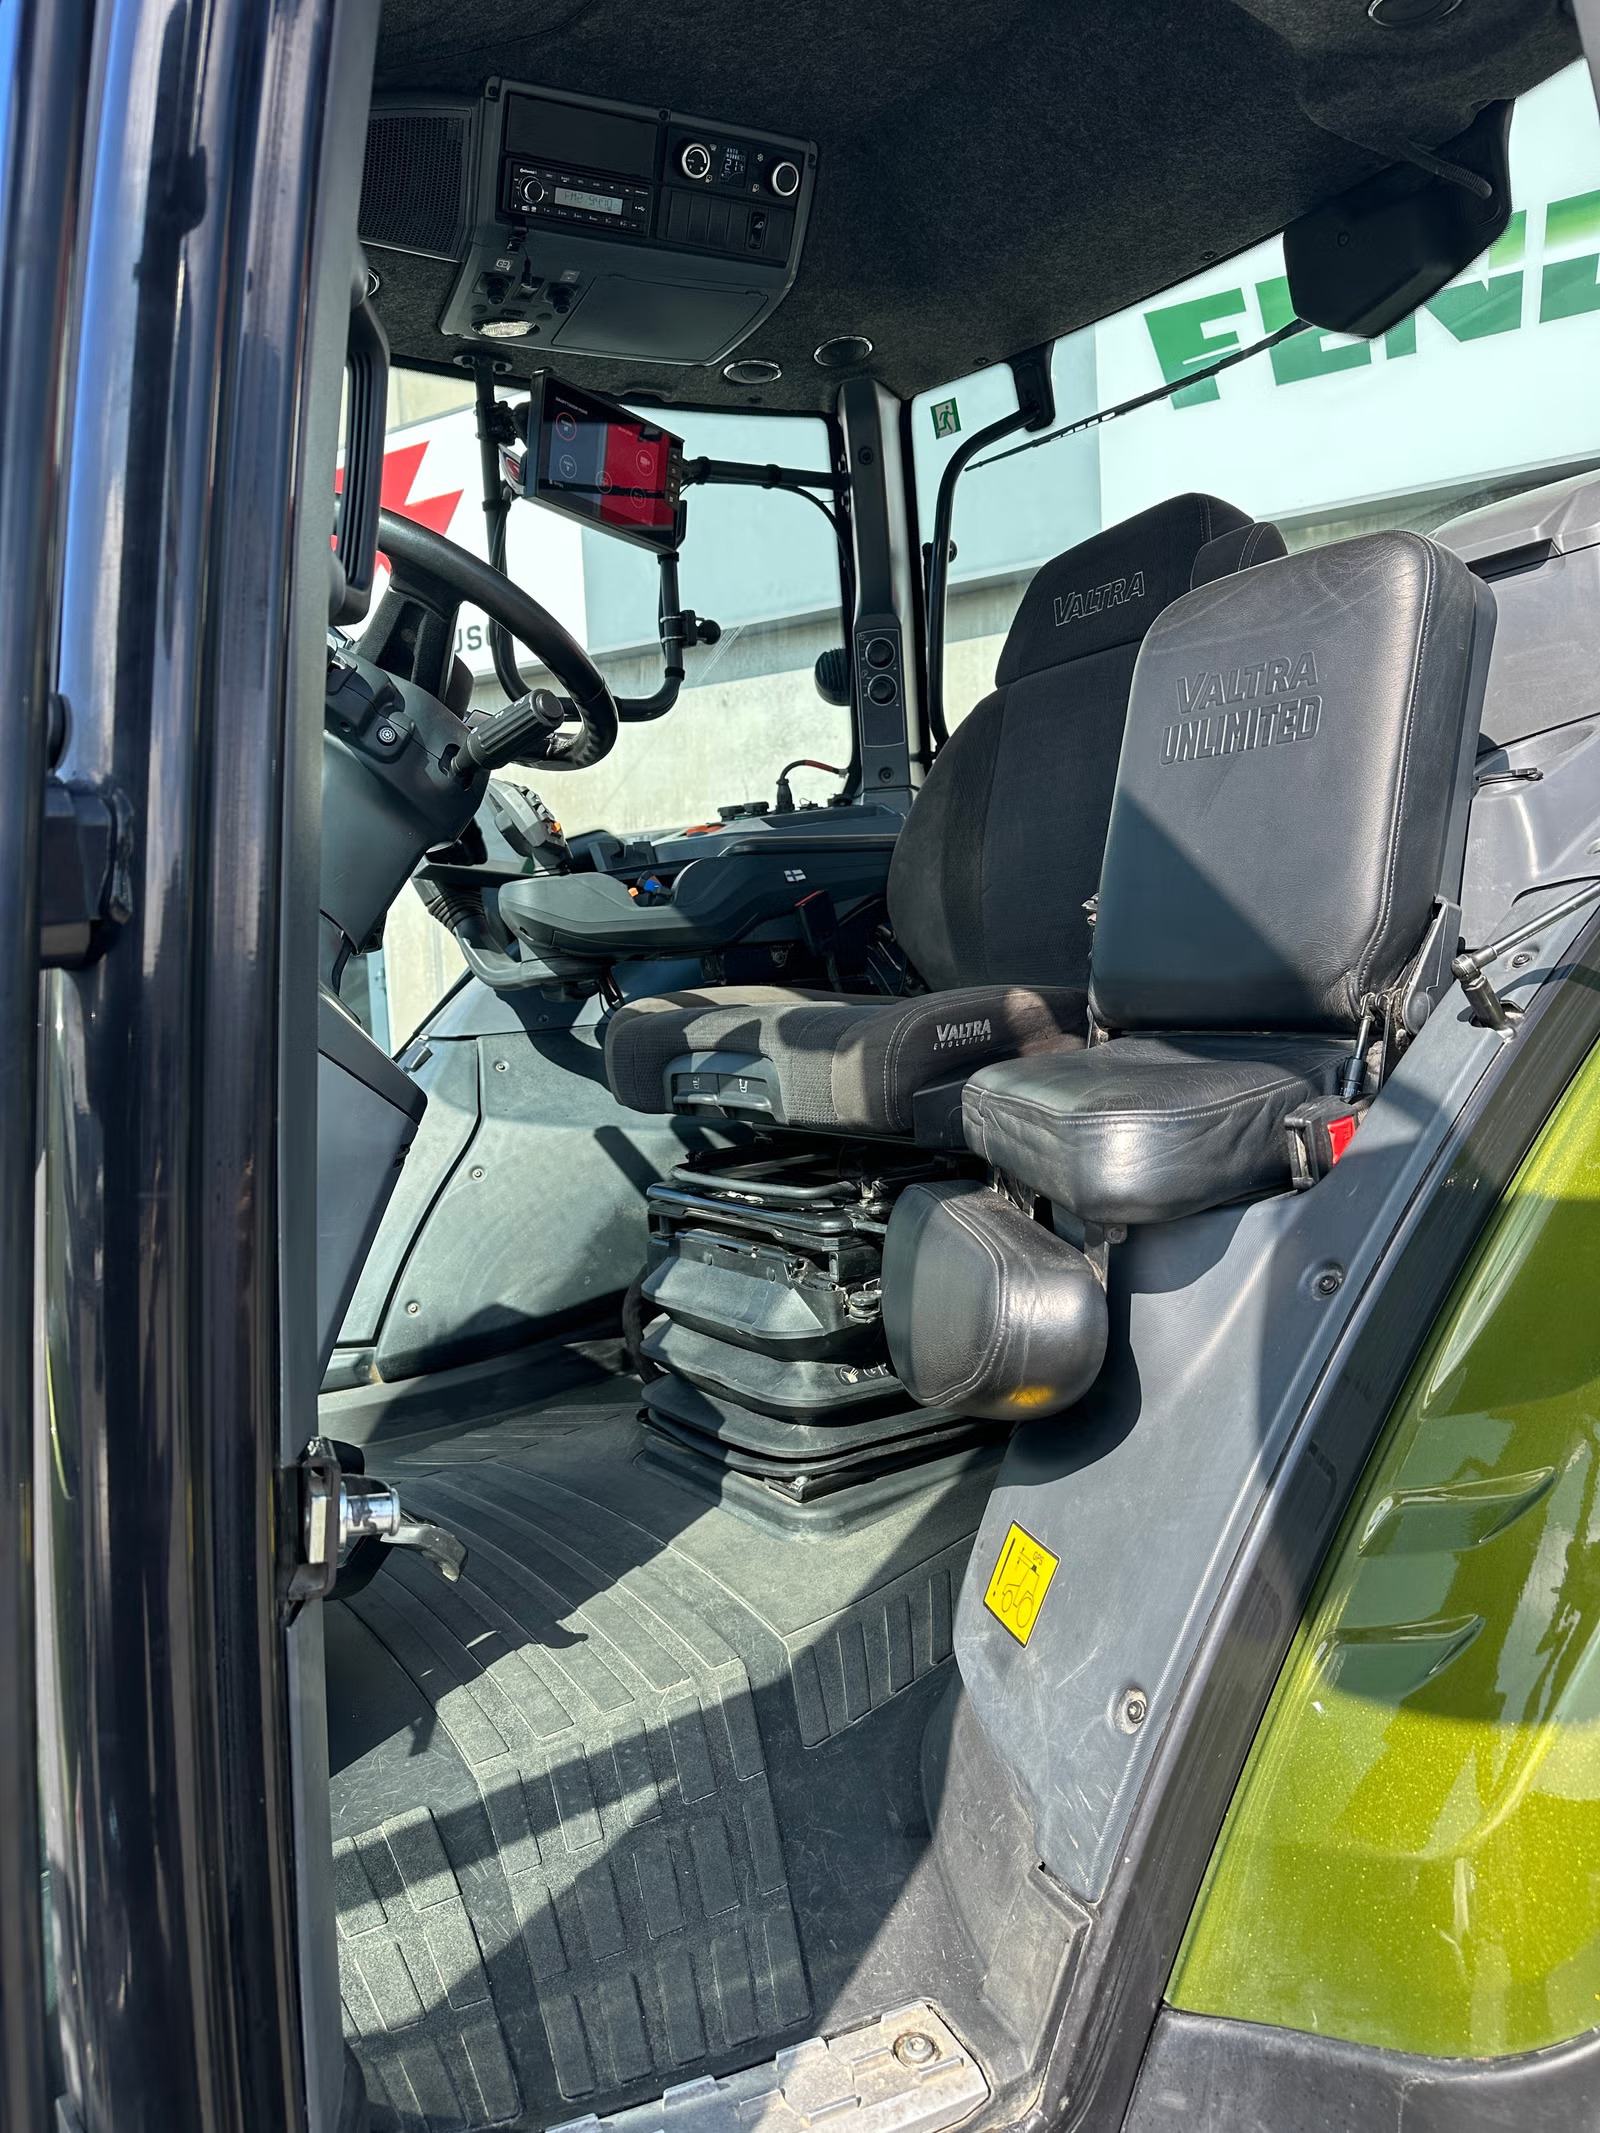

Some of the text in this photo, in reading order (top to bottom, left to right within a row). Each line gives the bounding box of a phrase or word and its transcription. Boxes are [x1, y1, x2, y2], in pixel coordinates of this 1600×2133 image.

[1053, 571, 1145, 627] VALTRA
[1176, 651, 1319, 714] VALTRA
[1160, 695, 1322, 765] UNLIMITED
[936, 1018, 992, 1042] VALTRA
